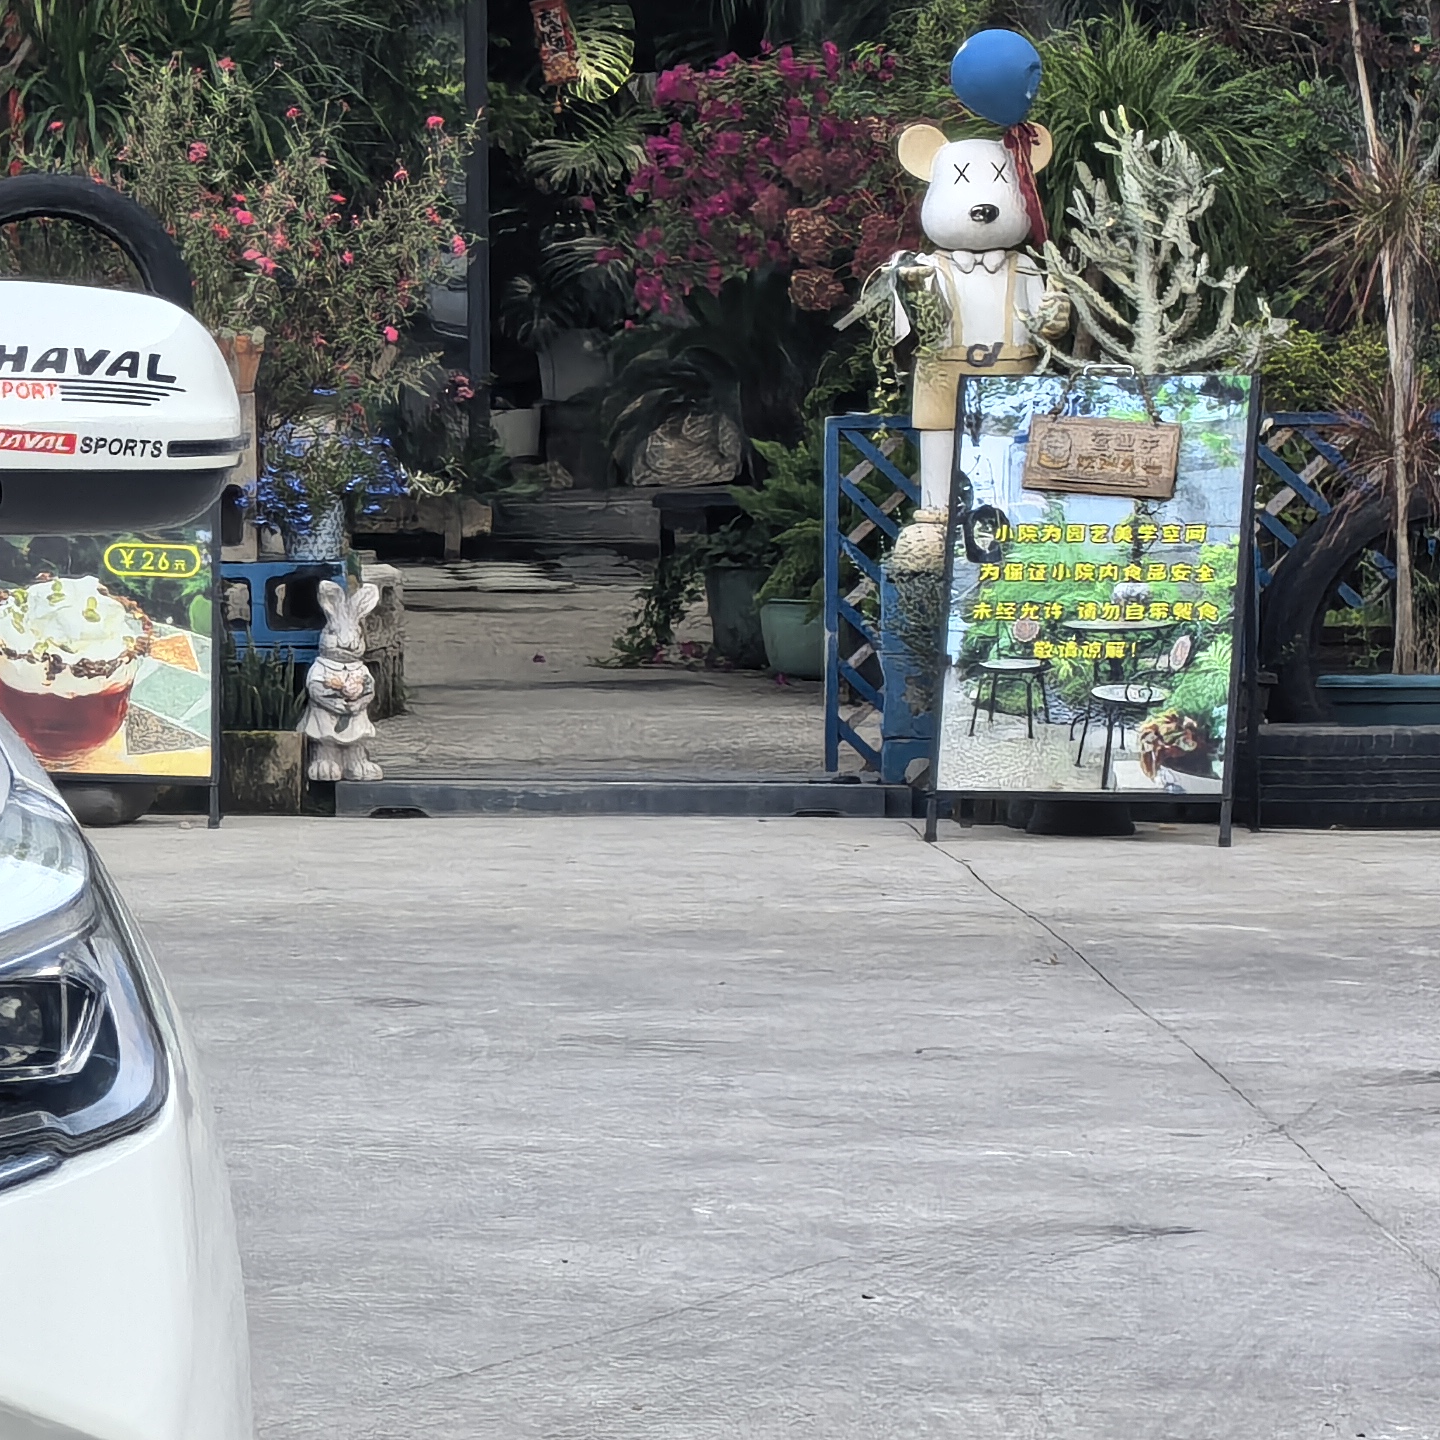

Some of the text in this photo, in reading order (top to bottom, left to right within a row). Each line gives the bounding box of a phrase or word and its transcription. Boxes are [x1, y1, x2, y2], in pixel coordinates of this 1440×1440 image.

[79, 436, 164, 459] SPORTS
[995, 523, 1207, 544] 小院为园艺美学空间
[979, 562, 1215, 583] 为保证小院内食品安全
